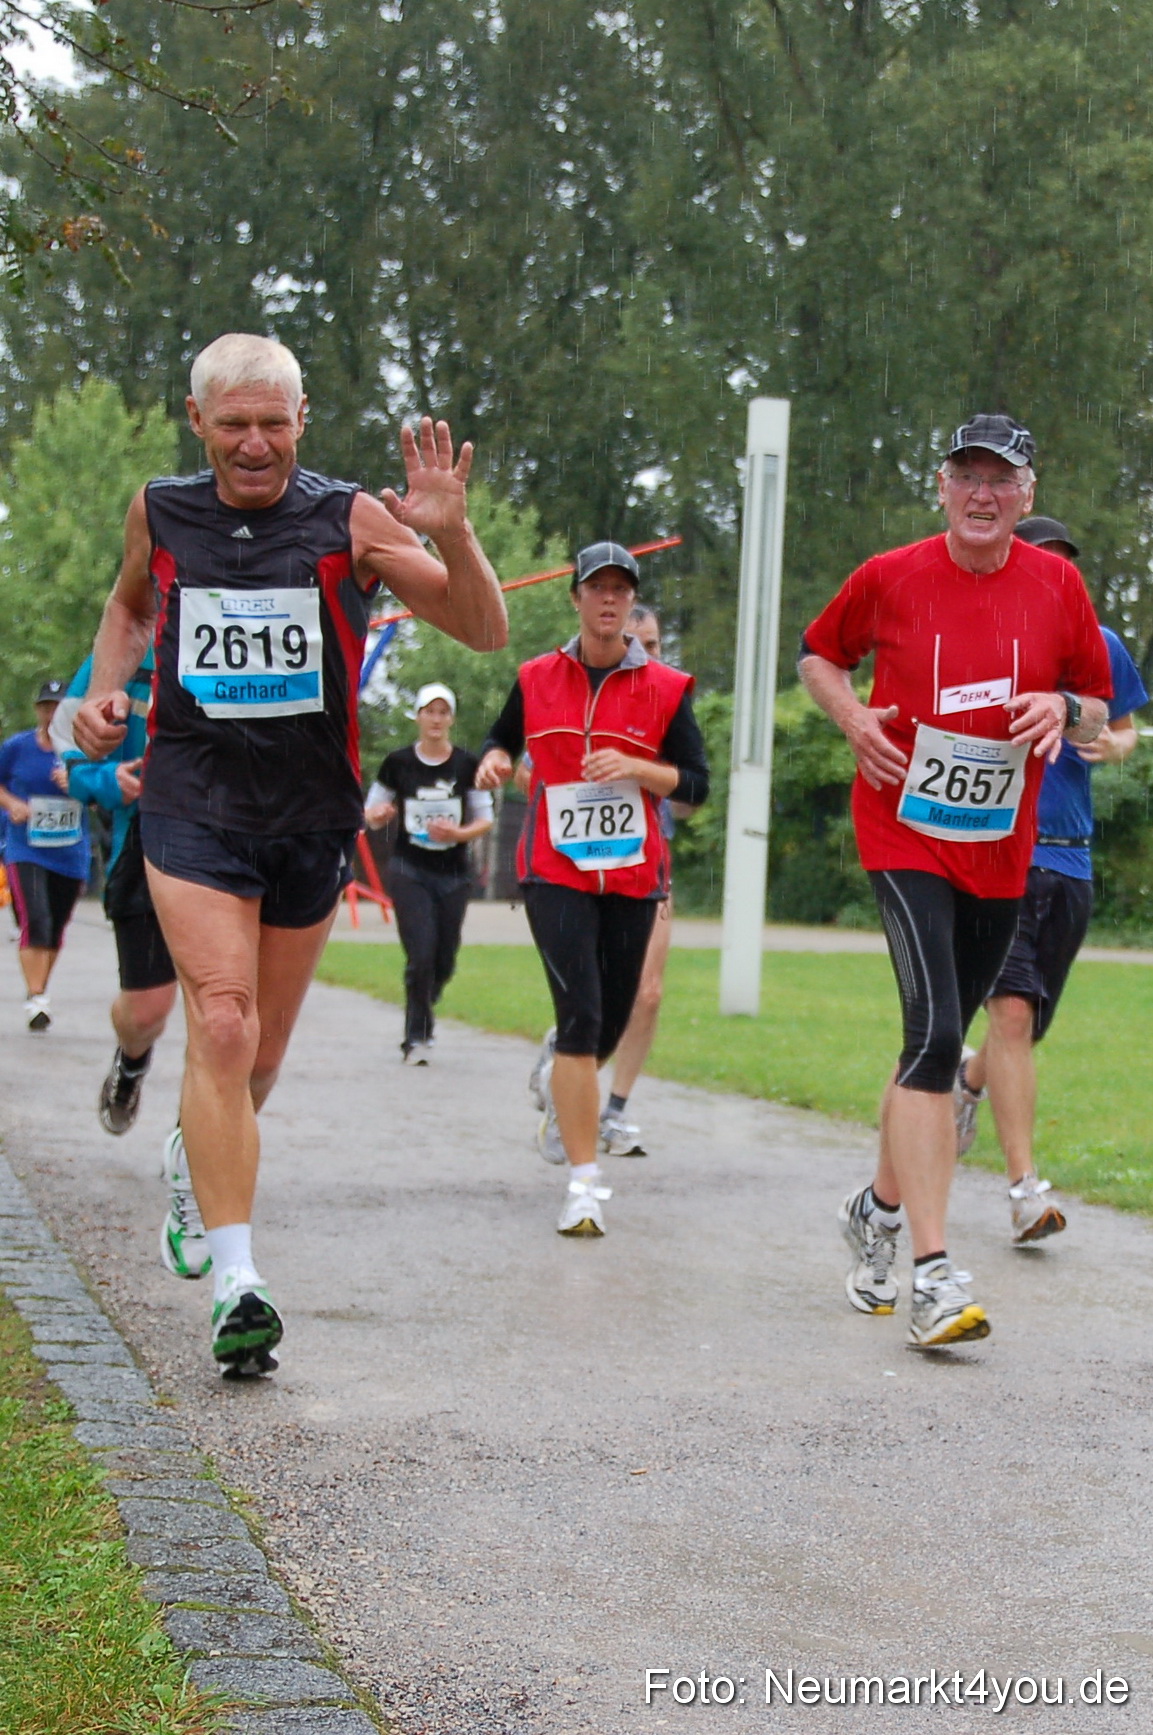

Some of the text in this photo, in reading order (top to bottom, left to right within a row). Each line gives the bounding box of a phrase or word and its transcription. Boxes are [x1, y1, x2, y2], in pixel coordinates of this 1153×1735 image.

[195, 624, 308, 669] 2619
[215, 680, 287, 699] Gerhard
[960, 690, 991, 703] DEHN
[918, 758, 1015, 805] 2657
[560, 803, 635, 838] 2782
[928, 807, 990, 828] Manfred
